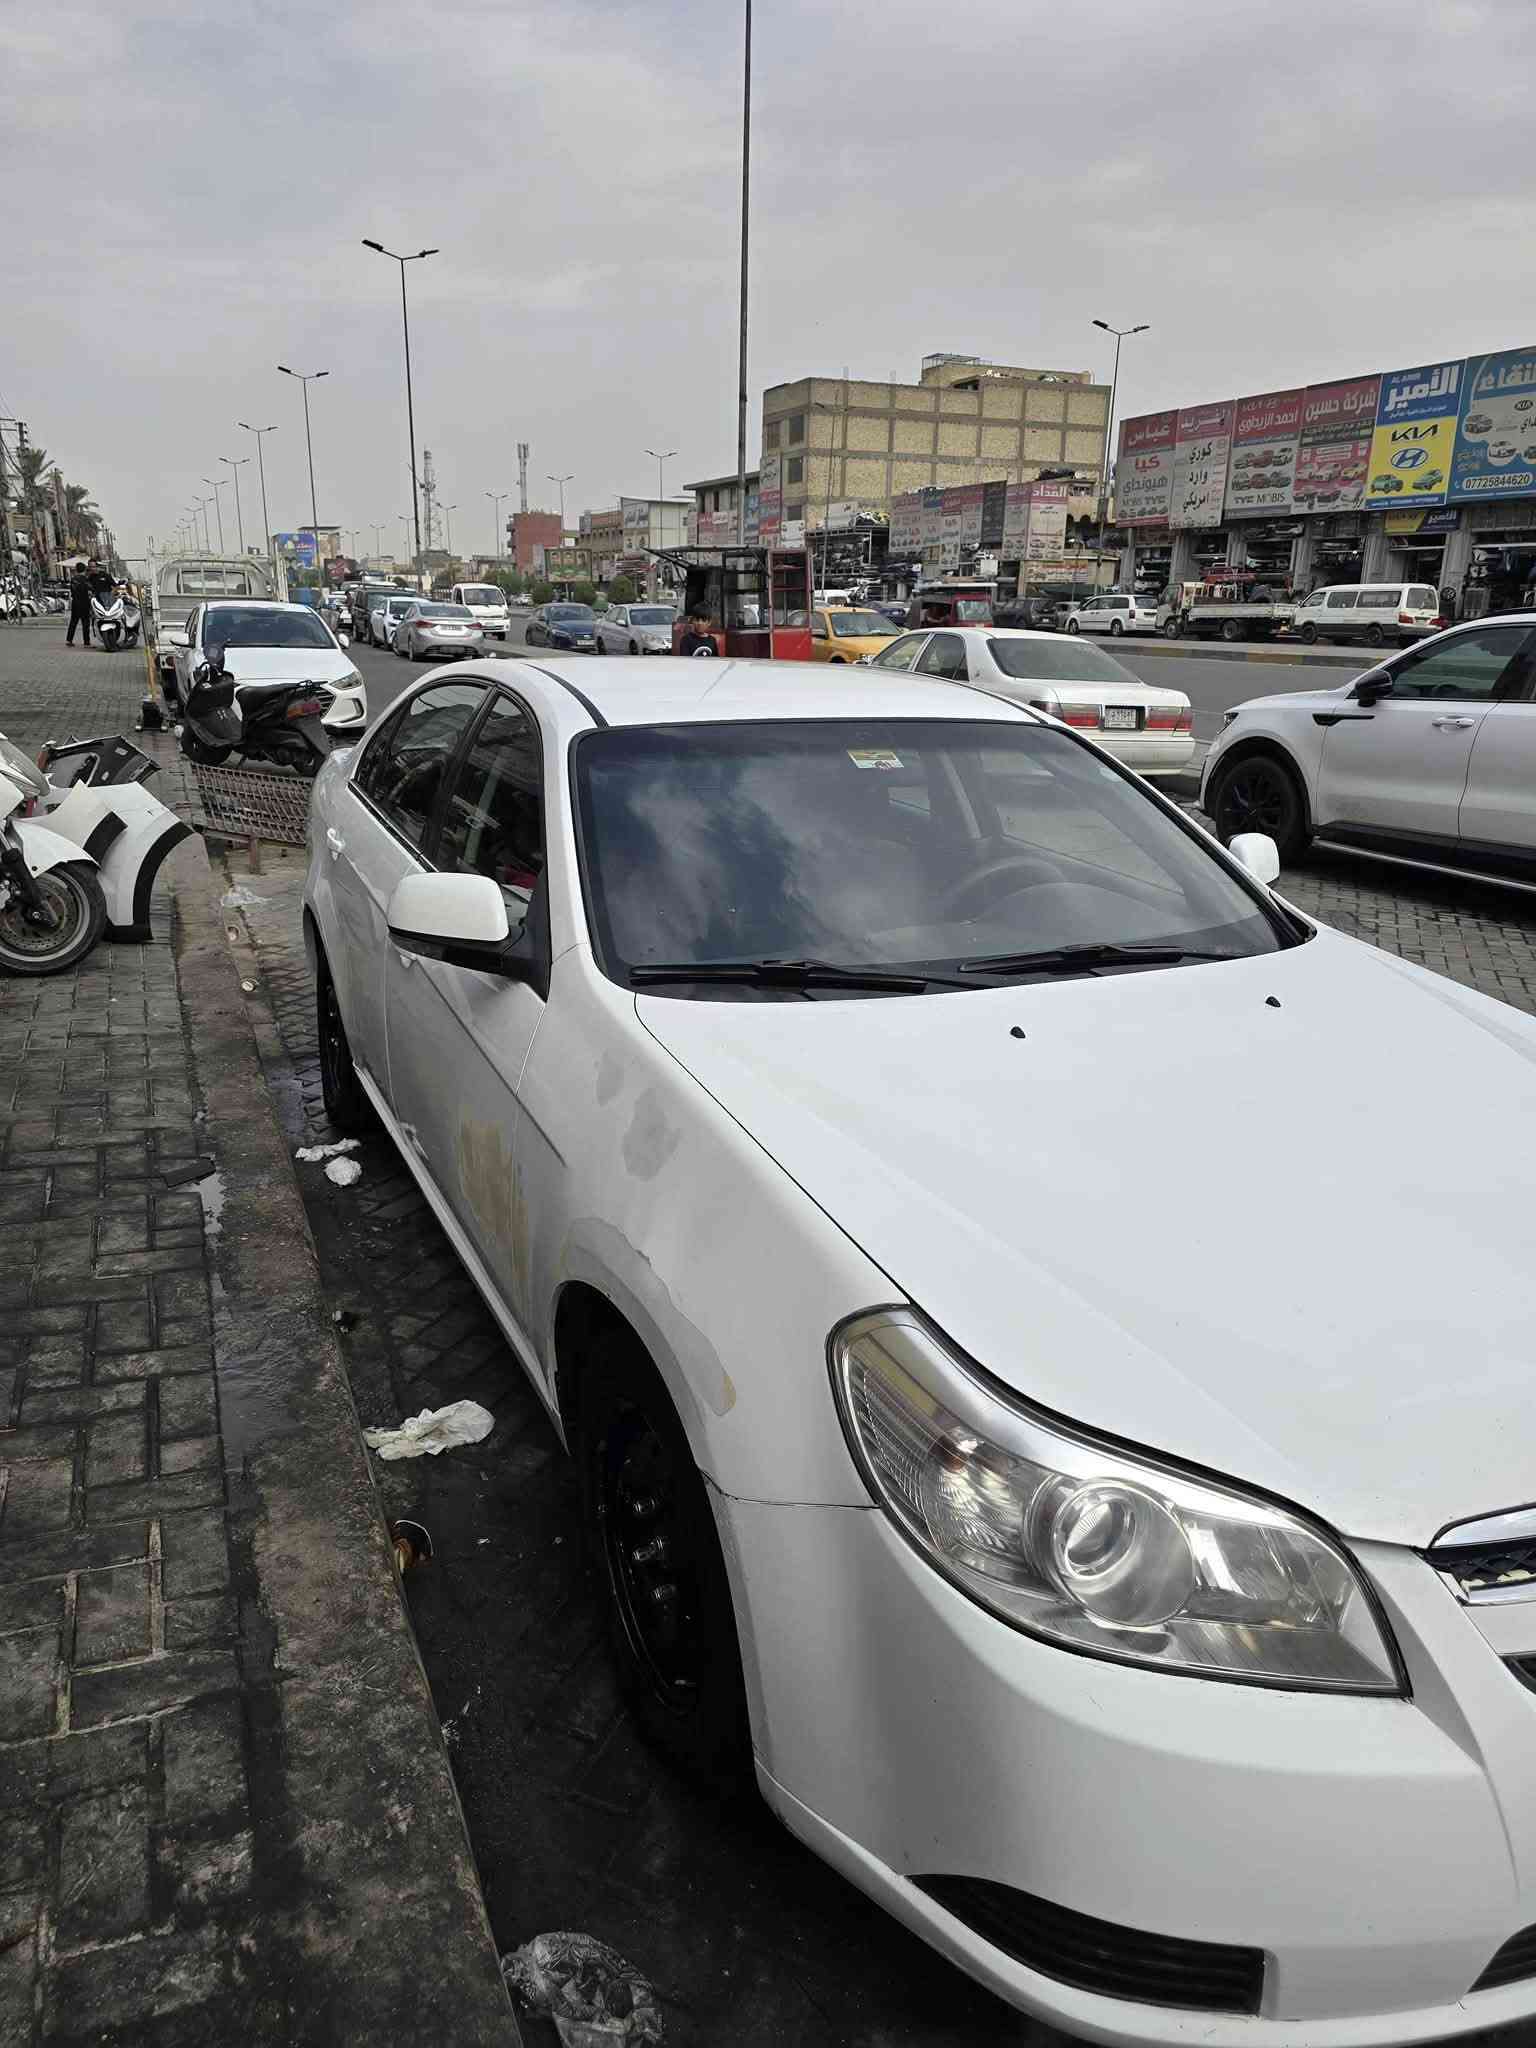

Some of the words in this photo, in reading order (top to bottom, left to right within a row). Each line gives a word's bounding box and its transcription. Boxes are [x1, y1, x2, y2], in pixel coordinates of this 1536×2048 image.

[1384, 366, 1459, 412] الأمير
[1305, 399, 1340, 422] حسين
[1343, 388, 1377, 414] شركة
[1391, 424, 1439, 442] KIA
[1135, 456, 1160, 473] كيا
